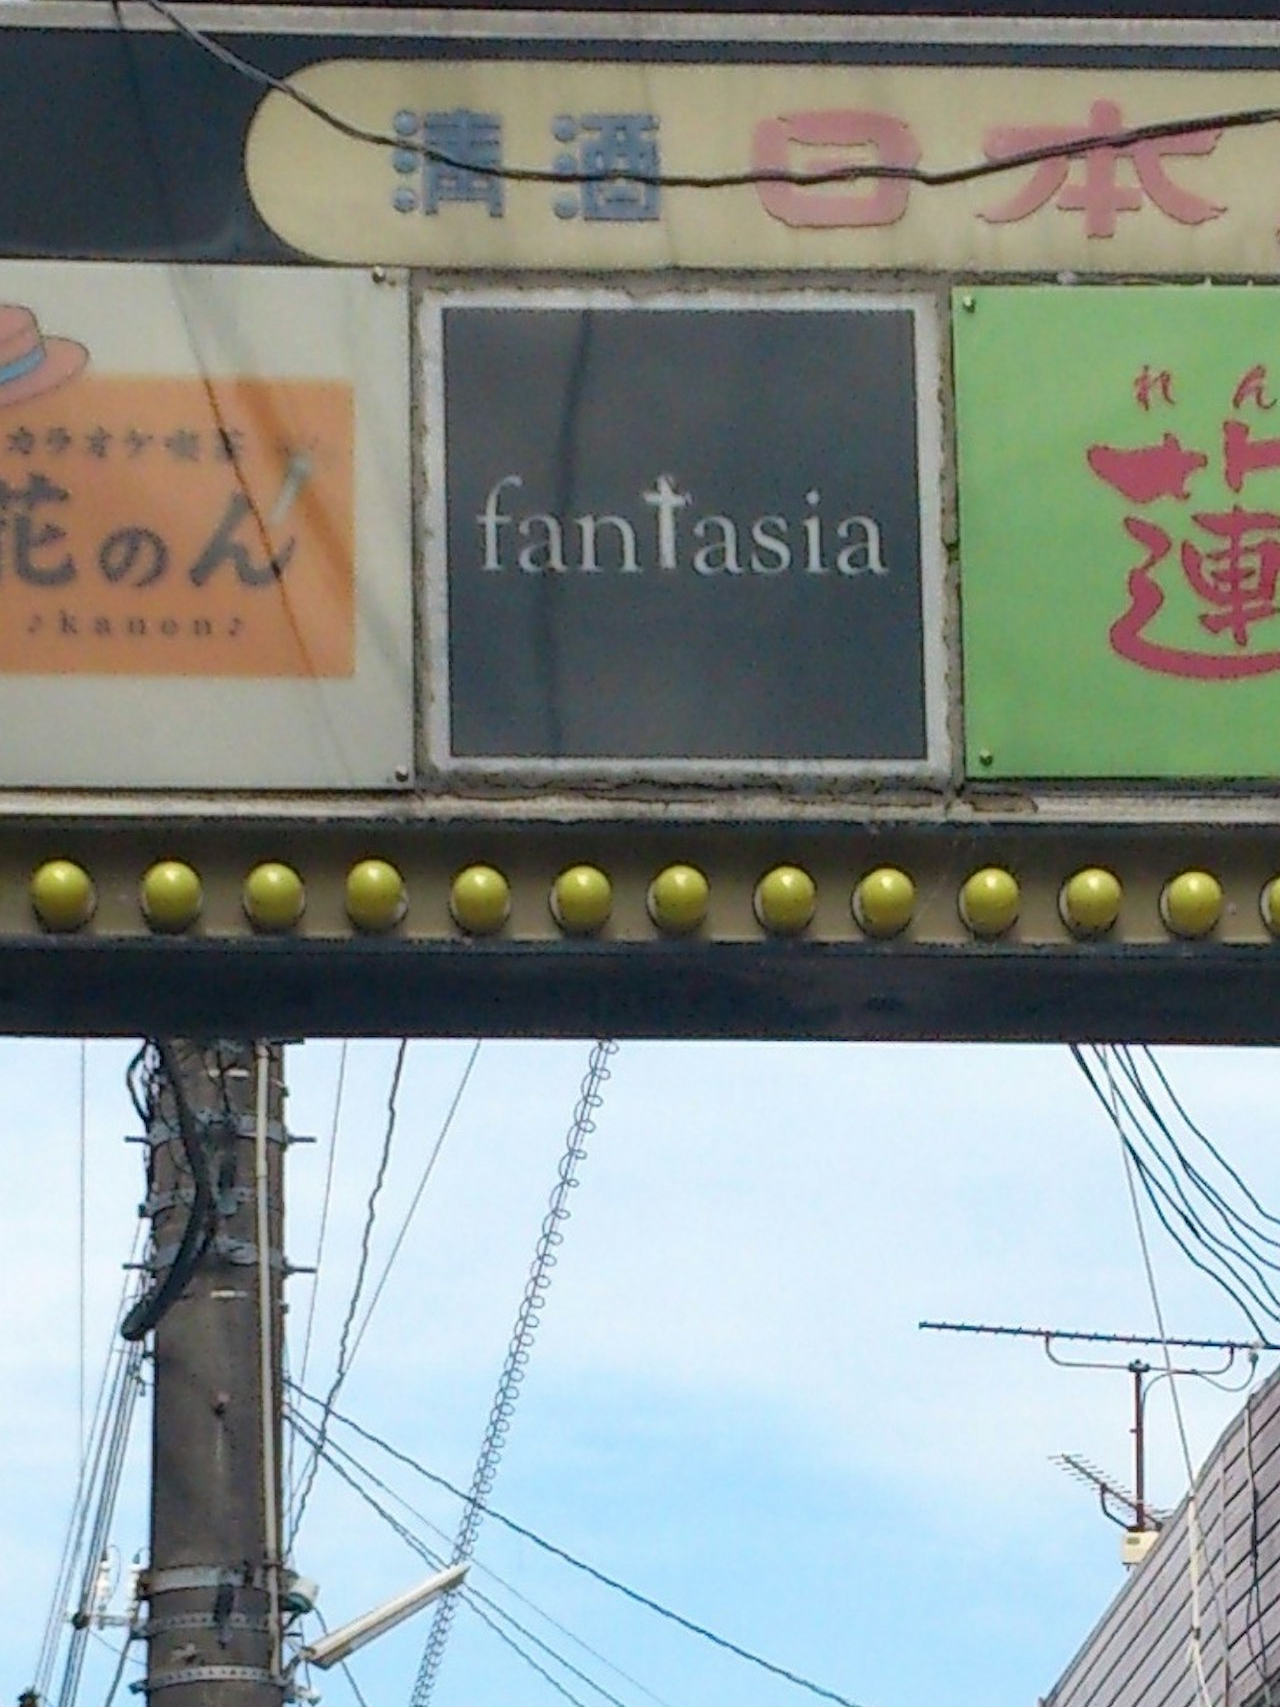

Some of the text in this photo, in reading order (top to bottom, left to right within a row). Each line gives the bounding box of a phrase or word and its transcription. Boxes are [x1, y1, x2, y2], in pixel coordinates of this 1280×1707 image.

[391, 107, 662, 224] 清酒
[1134, 363, 1278, 412] れん
[476, 474, 889, 577] fantasia
[58, 612, 214, 638] kanon
